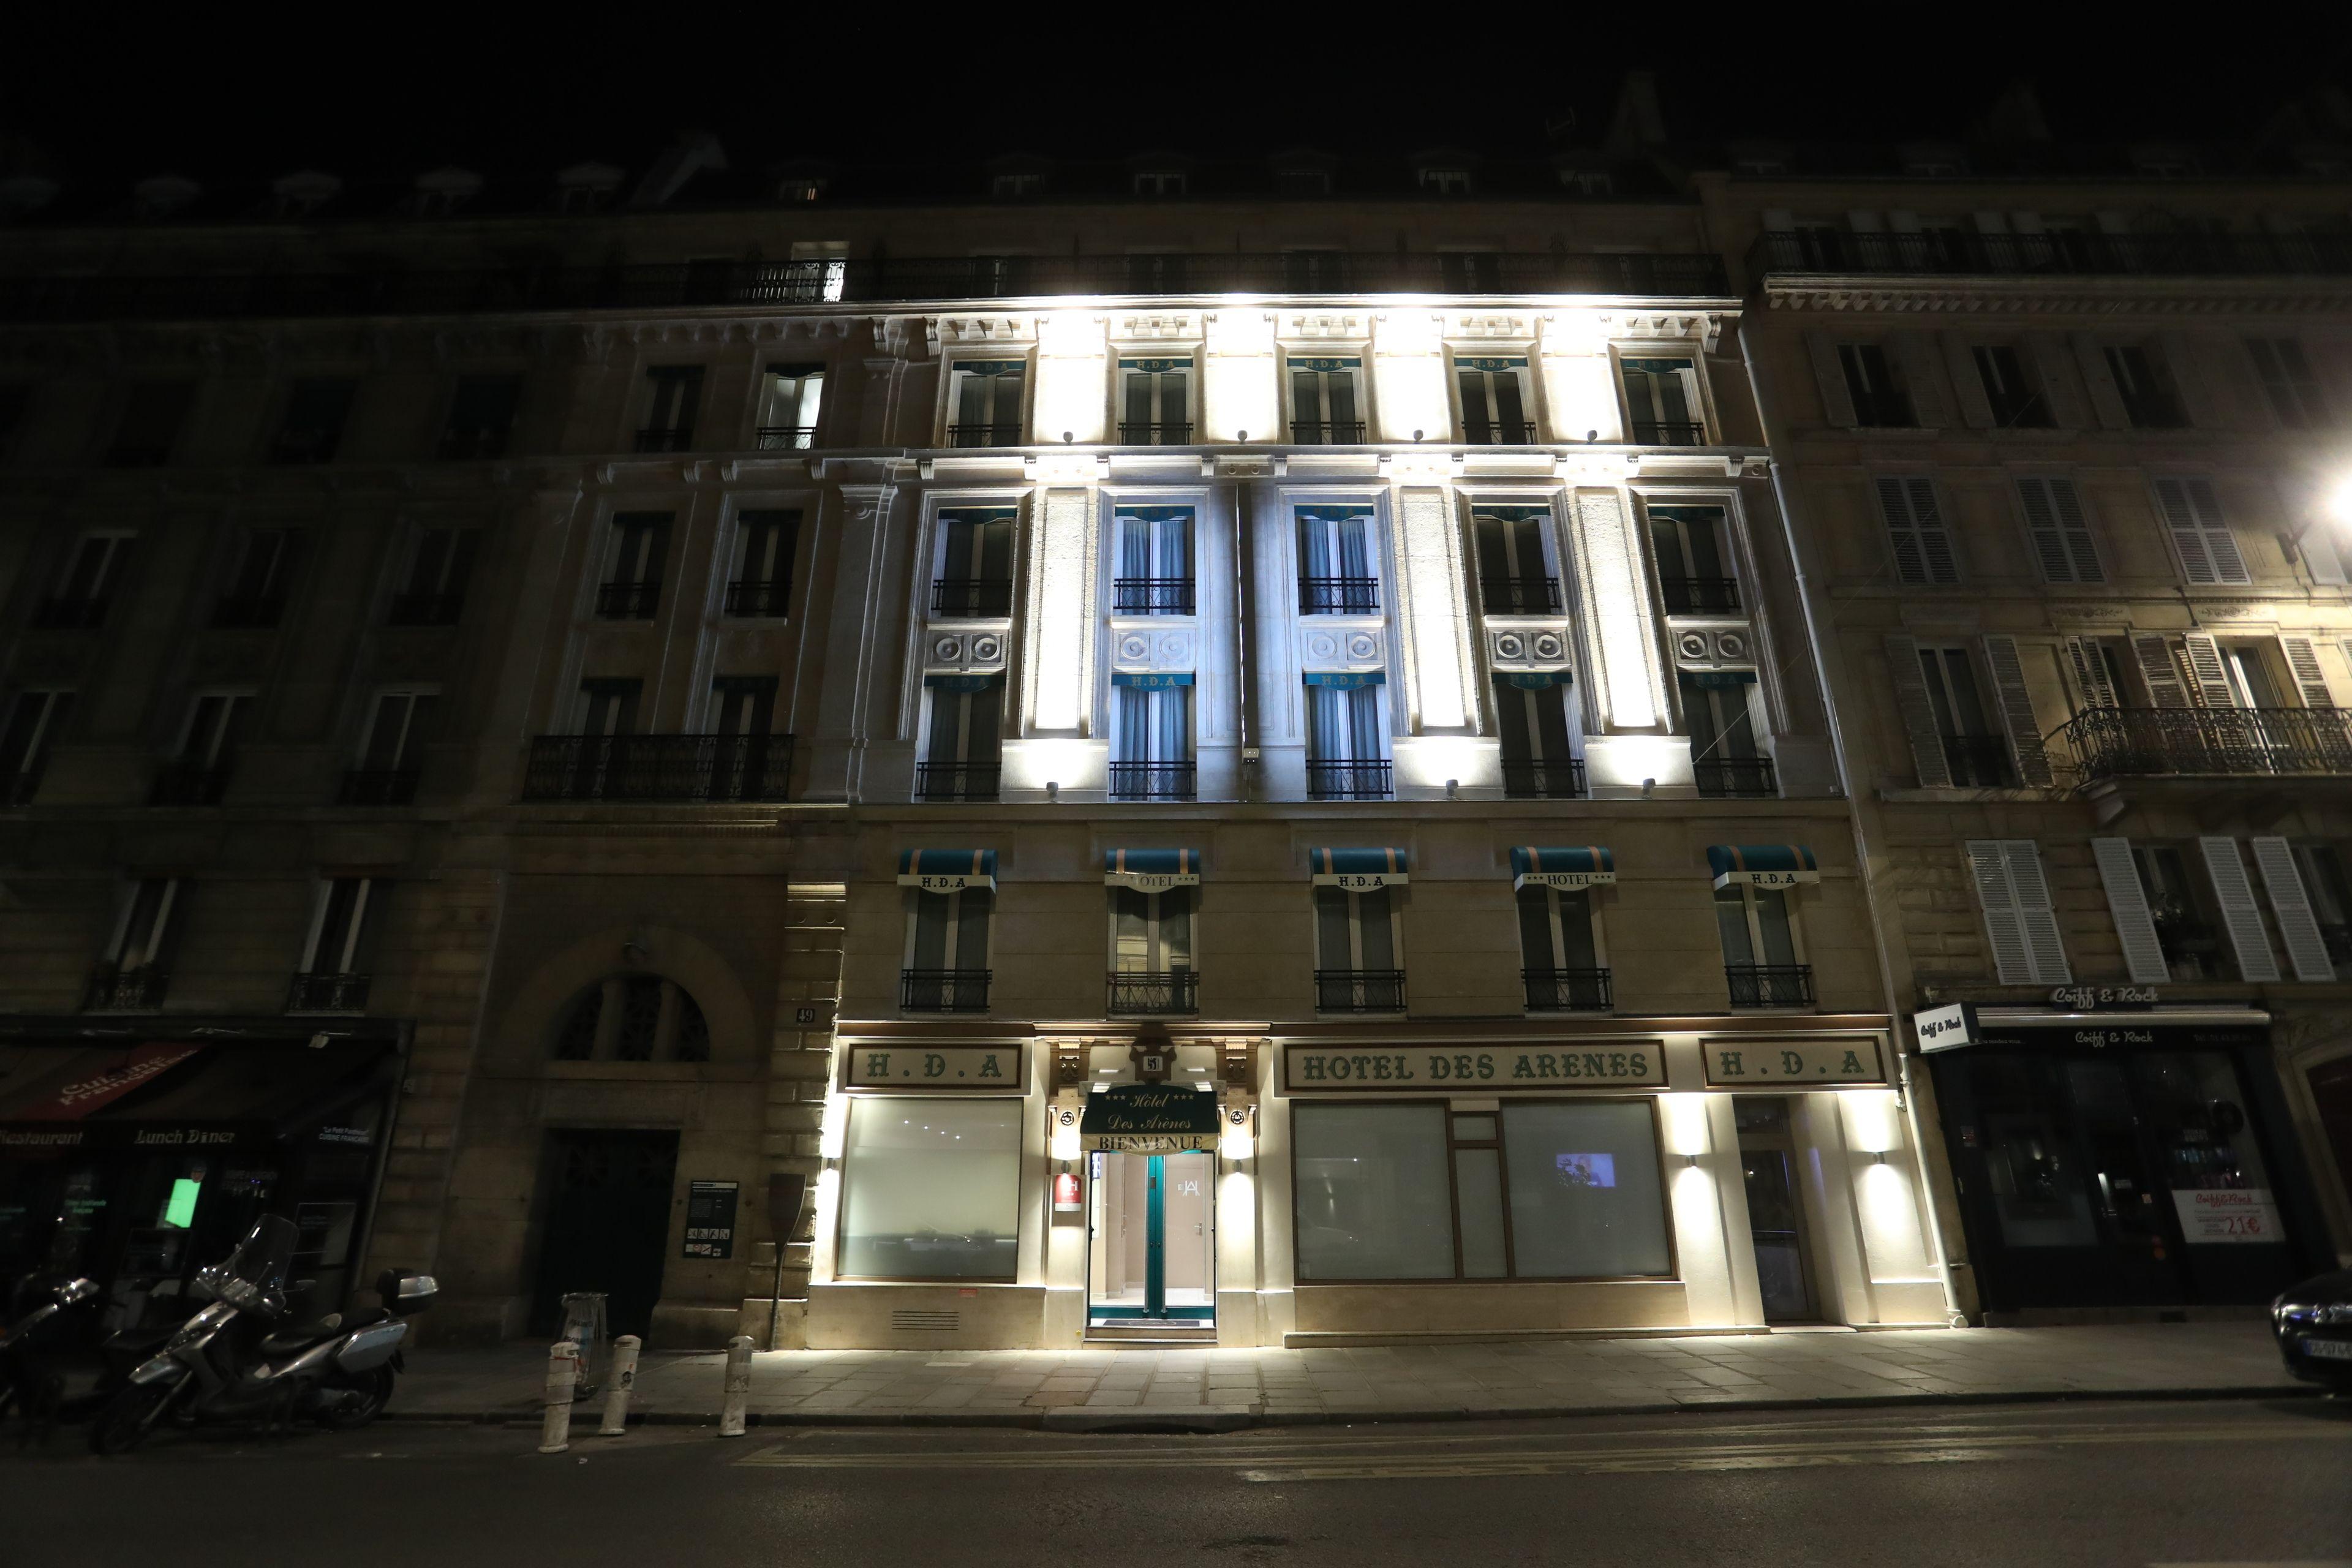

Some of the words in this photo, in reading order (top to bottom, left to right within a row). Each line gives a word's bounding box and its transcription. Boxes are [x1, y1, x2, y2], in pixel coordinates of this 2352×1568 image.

[1131, 876, 1176, 887] OTEL
[1548, 875, 1593, 885] HOTEL
[2100, 989, 2114, 1002] &
[2116, 987, 2159, 1002] Rock
[798, 1009, 813, 1022] 49
[1945, 1017, 1961, 1031] Rock
[2109, 1033, 2120, 1042] &
[2124, 1030, 2154, 1042] Rock
[1303, 1055, 1414, 1080] HOTEL
[1428, 1054, 1495, 1080] DES
[1512, 1052, 1648, 1079] ARENES
[1129, 1093, 1170, 1107] Hôtel
[1108, 1114, 1133, 1129] Des
[1140, 1114, 1191, 1129] Arènes
[134, 1130, 183, 1144] Lunch
[1099, 1136, 1202, 1150] BIENVENUE
